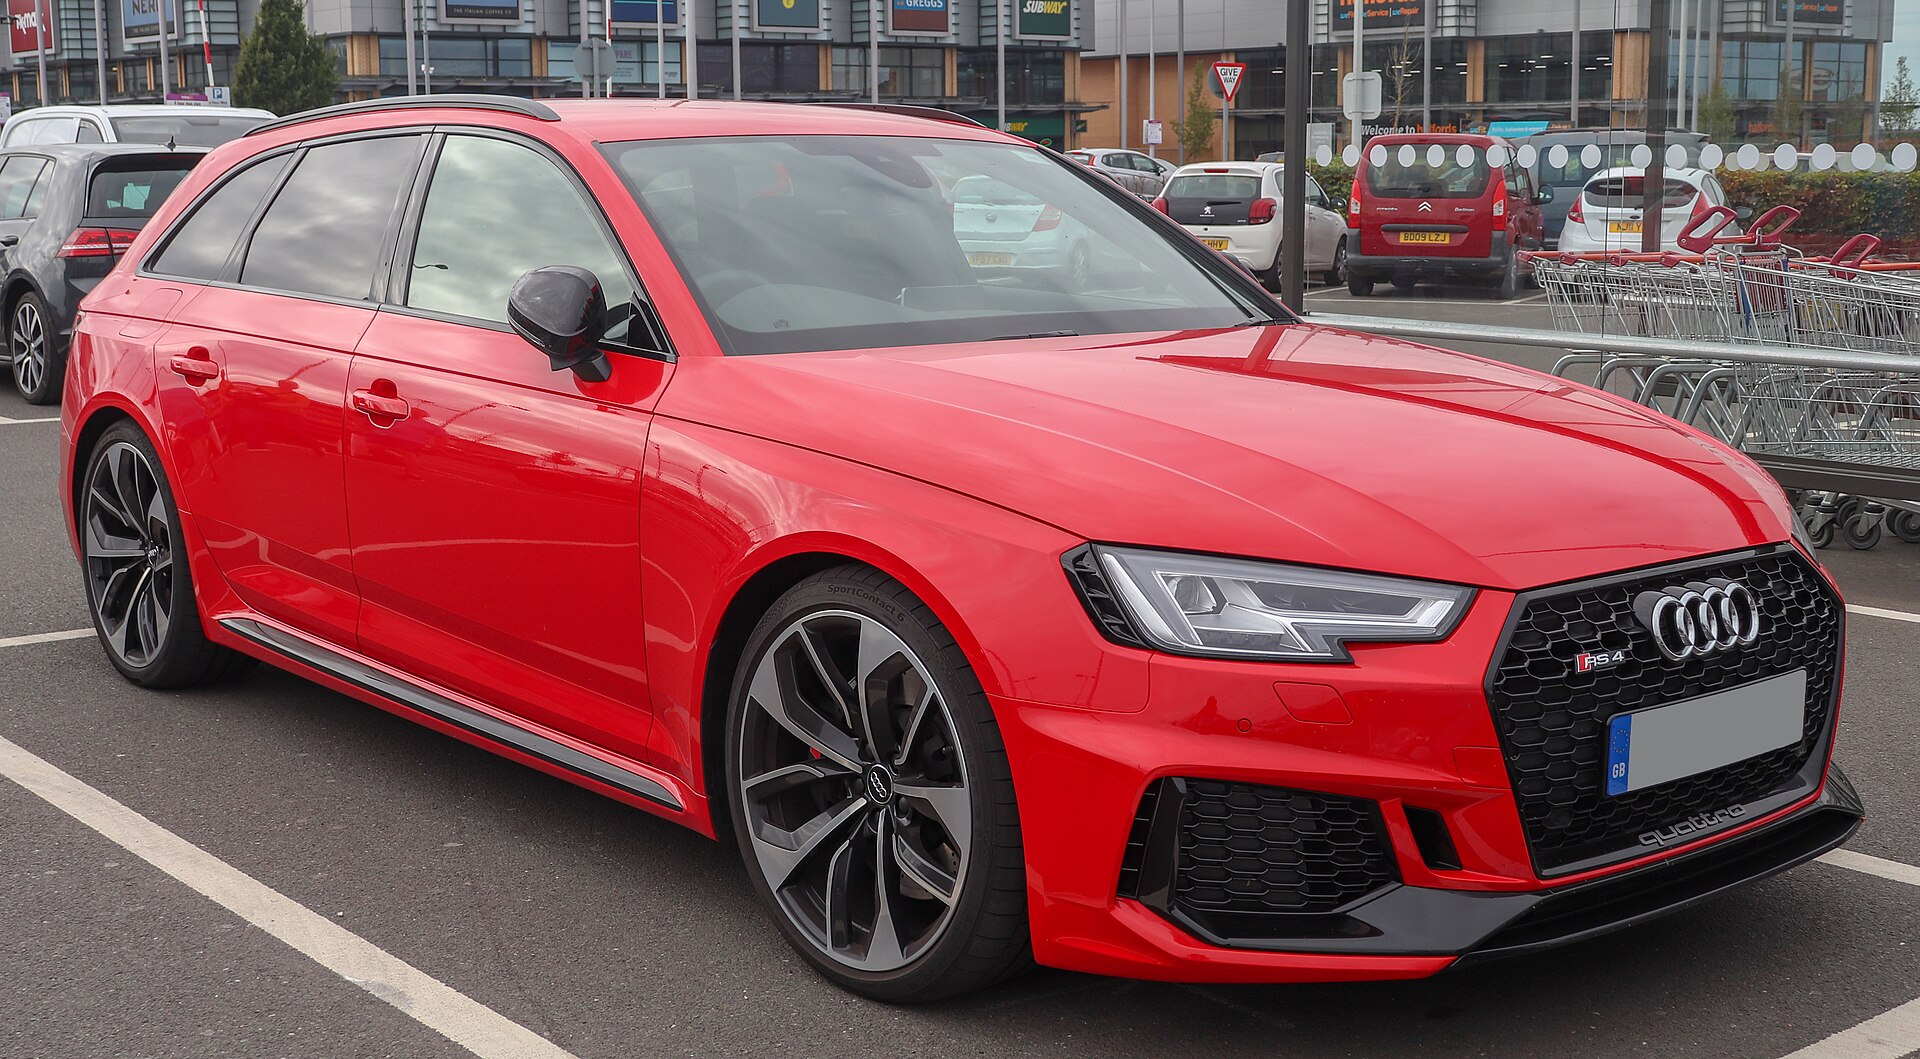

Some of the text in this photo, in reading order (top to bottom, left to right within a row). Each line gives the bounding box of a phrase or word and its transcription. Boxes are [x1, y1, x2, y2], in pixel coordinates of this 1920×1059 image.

[132, 0, 159, 15] NER
[1023, 0, 1067, 14] SUBWAY
[1220, 67, 1239, 77] GIVE
[1361, 123, 1457, 135] Welcome to hfords
[1403, 232, 1447, 242] BD09 LZJ
[827, 584, 906, 622] SportContact 6
[1583, 650, 1625, 669] RS 4
[1612, 762, 1626, 779] GB
[1638, 803, 1747, 847] quattro
